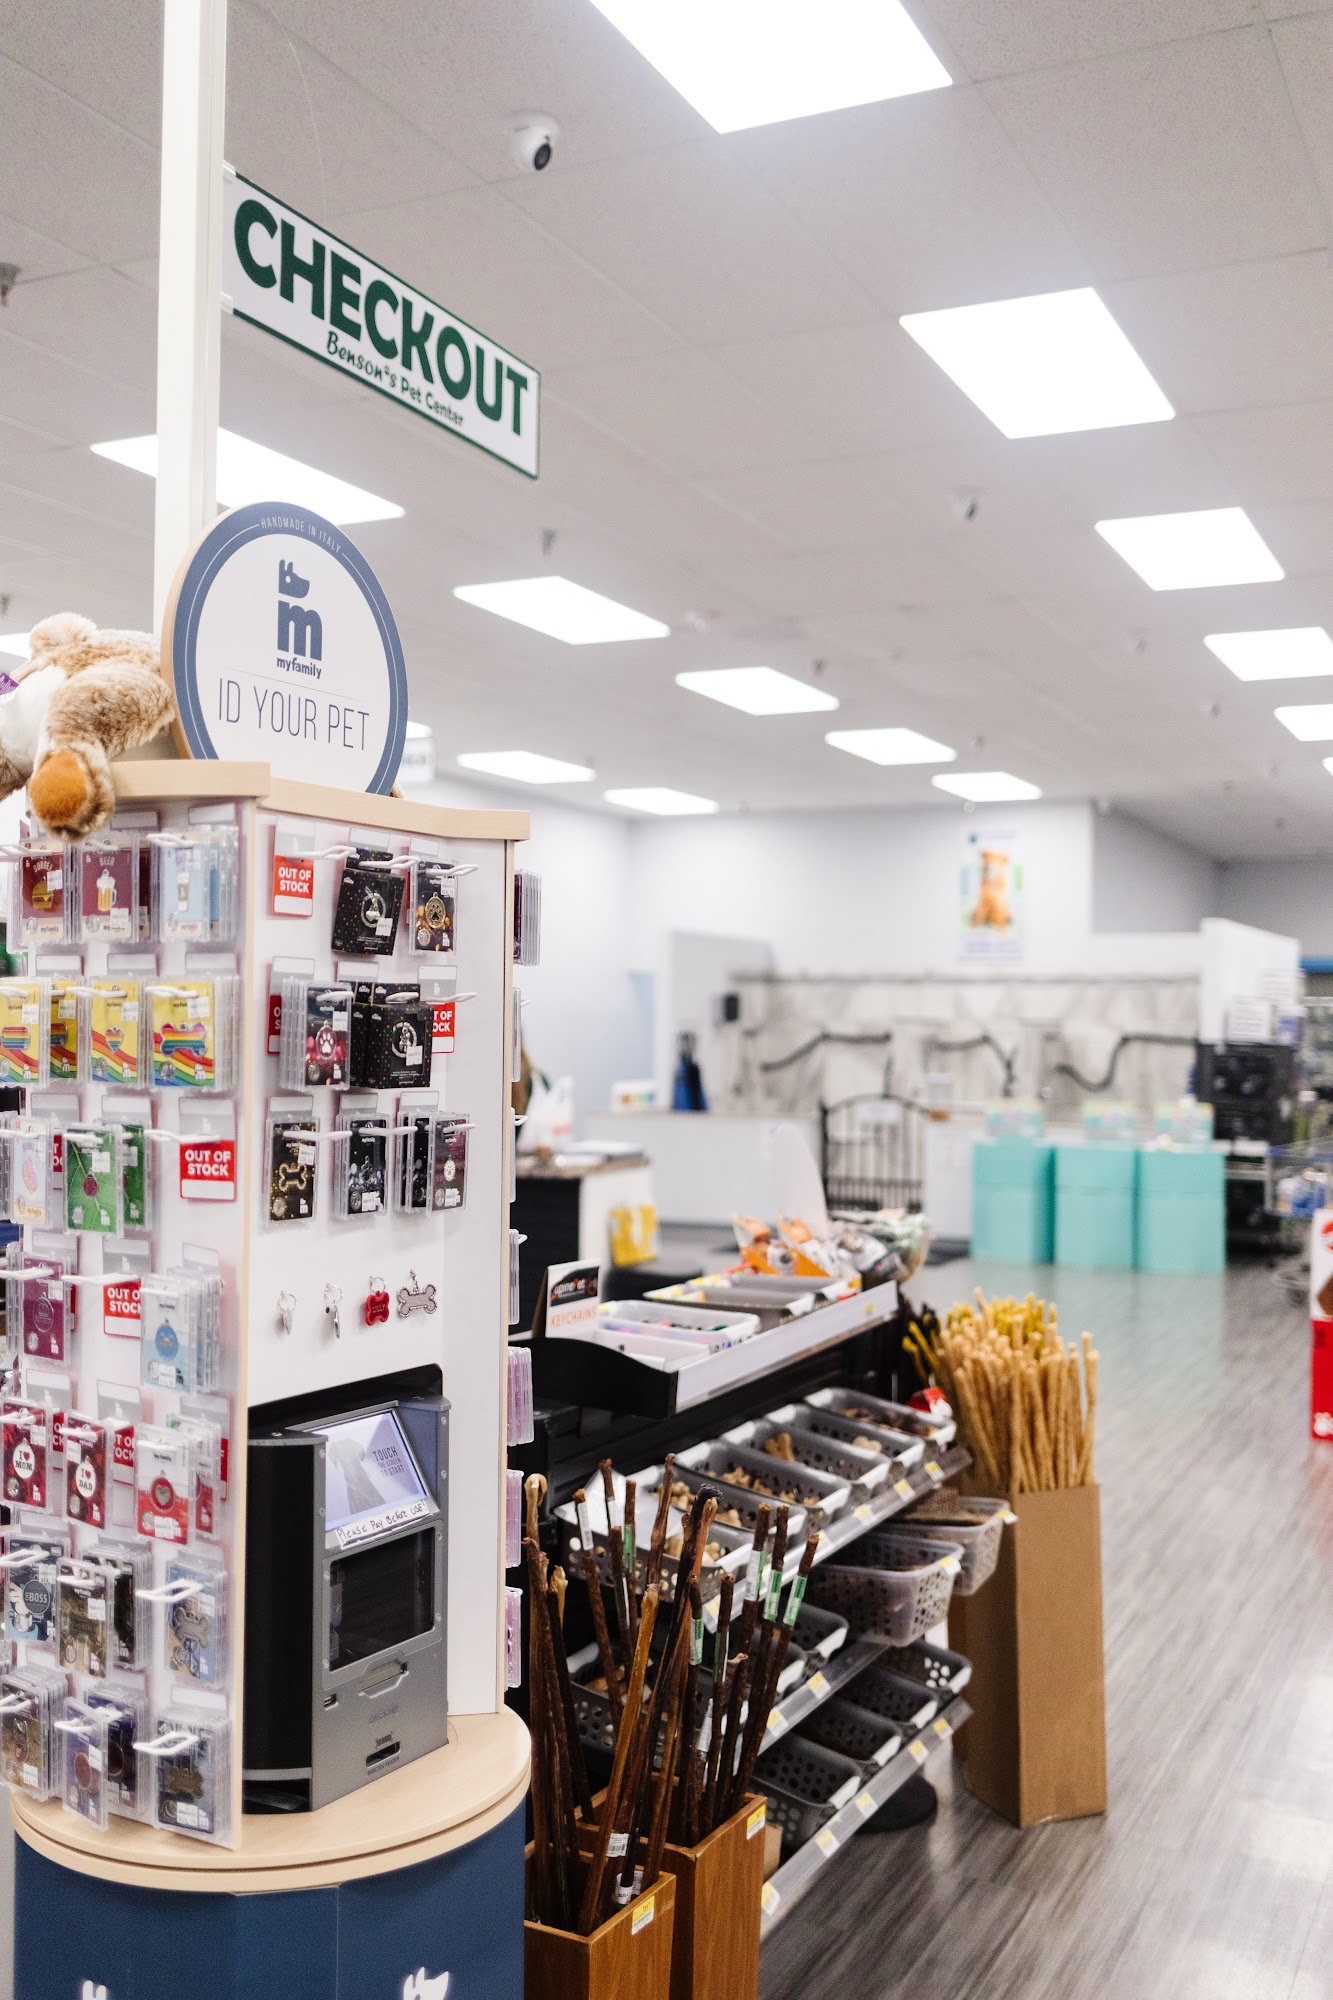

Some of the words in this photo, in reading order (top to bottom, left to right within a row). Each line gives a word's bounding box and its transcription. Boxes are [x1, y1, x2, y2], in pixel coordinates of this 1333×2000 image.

[234, 199, 528, 436] CHECKOUT
[327, 331, 397, 388] Benson's
[401, 376, 422, 401] Pet
[425, 392, 464, 426] Center
[260, 516, 305, 532] HANDMADE
[308, 524, 316, 537] IN
[319, 531, 342, 553] ITALY
[277, 657, 322, 679] myfamily
[219, 678, 241, 724] ID
[253, 686, 317, 740] YOUR
[328, 704, 370, 750] PET
[278, 867, 297, 880] OUT
[299, 869, 311, 881] OF
[280, 880, 309, 893] STOCK
[440, 1010, 453, 1020] OF
[433, 1022, 450, 1032] OCK
[185, 1149, 211, 1161] OUT
[213, 1151, 231, 1163] OF
[187, 1163, 229, 1176] STOCK
[107, 1287, 129, 1300] OUT
[131, 1290, 141, 1301] O
[551, 1307, 597, 1328] KEYCHAINS
[372, 1446, 399, 1461] TOUCH
[15, 1460, 33, 1471] MOM
[380, 1468, 388, 1477] TO
[389, 1464, 405, 1476] START
[79, 1480, 93, 1491] DAD
[337, 1524, 367, 1541] Please
[370, 1517, 383, 1531] Pay
[30, 1590, 48, 1604] BOSS
